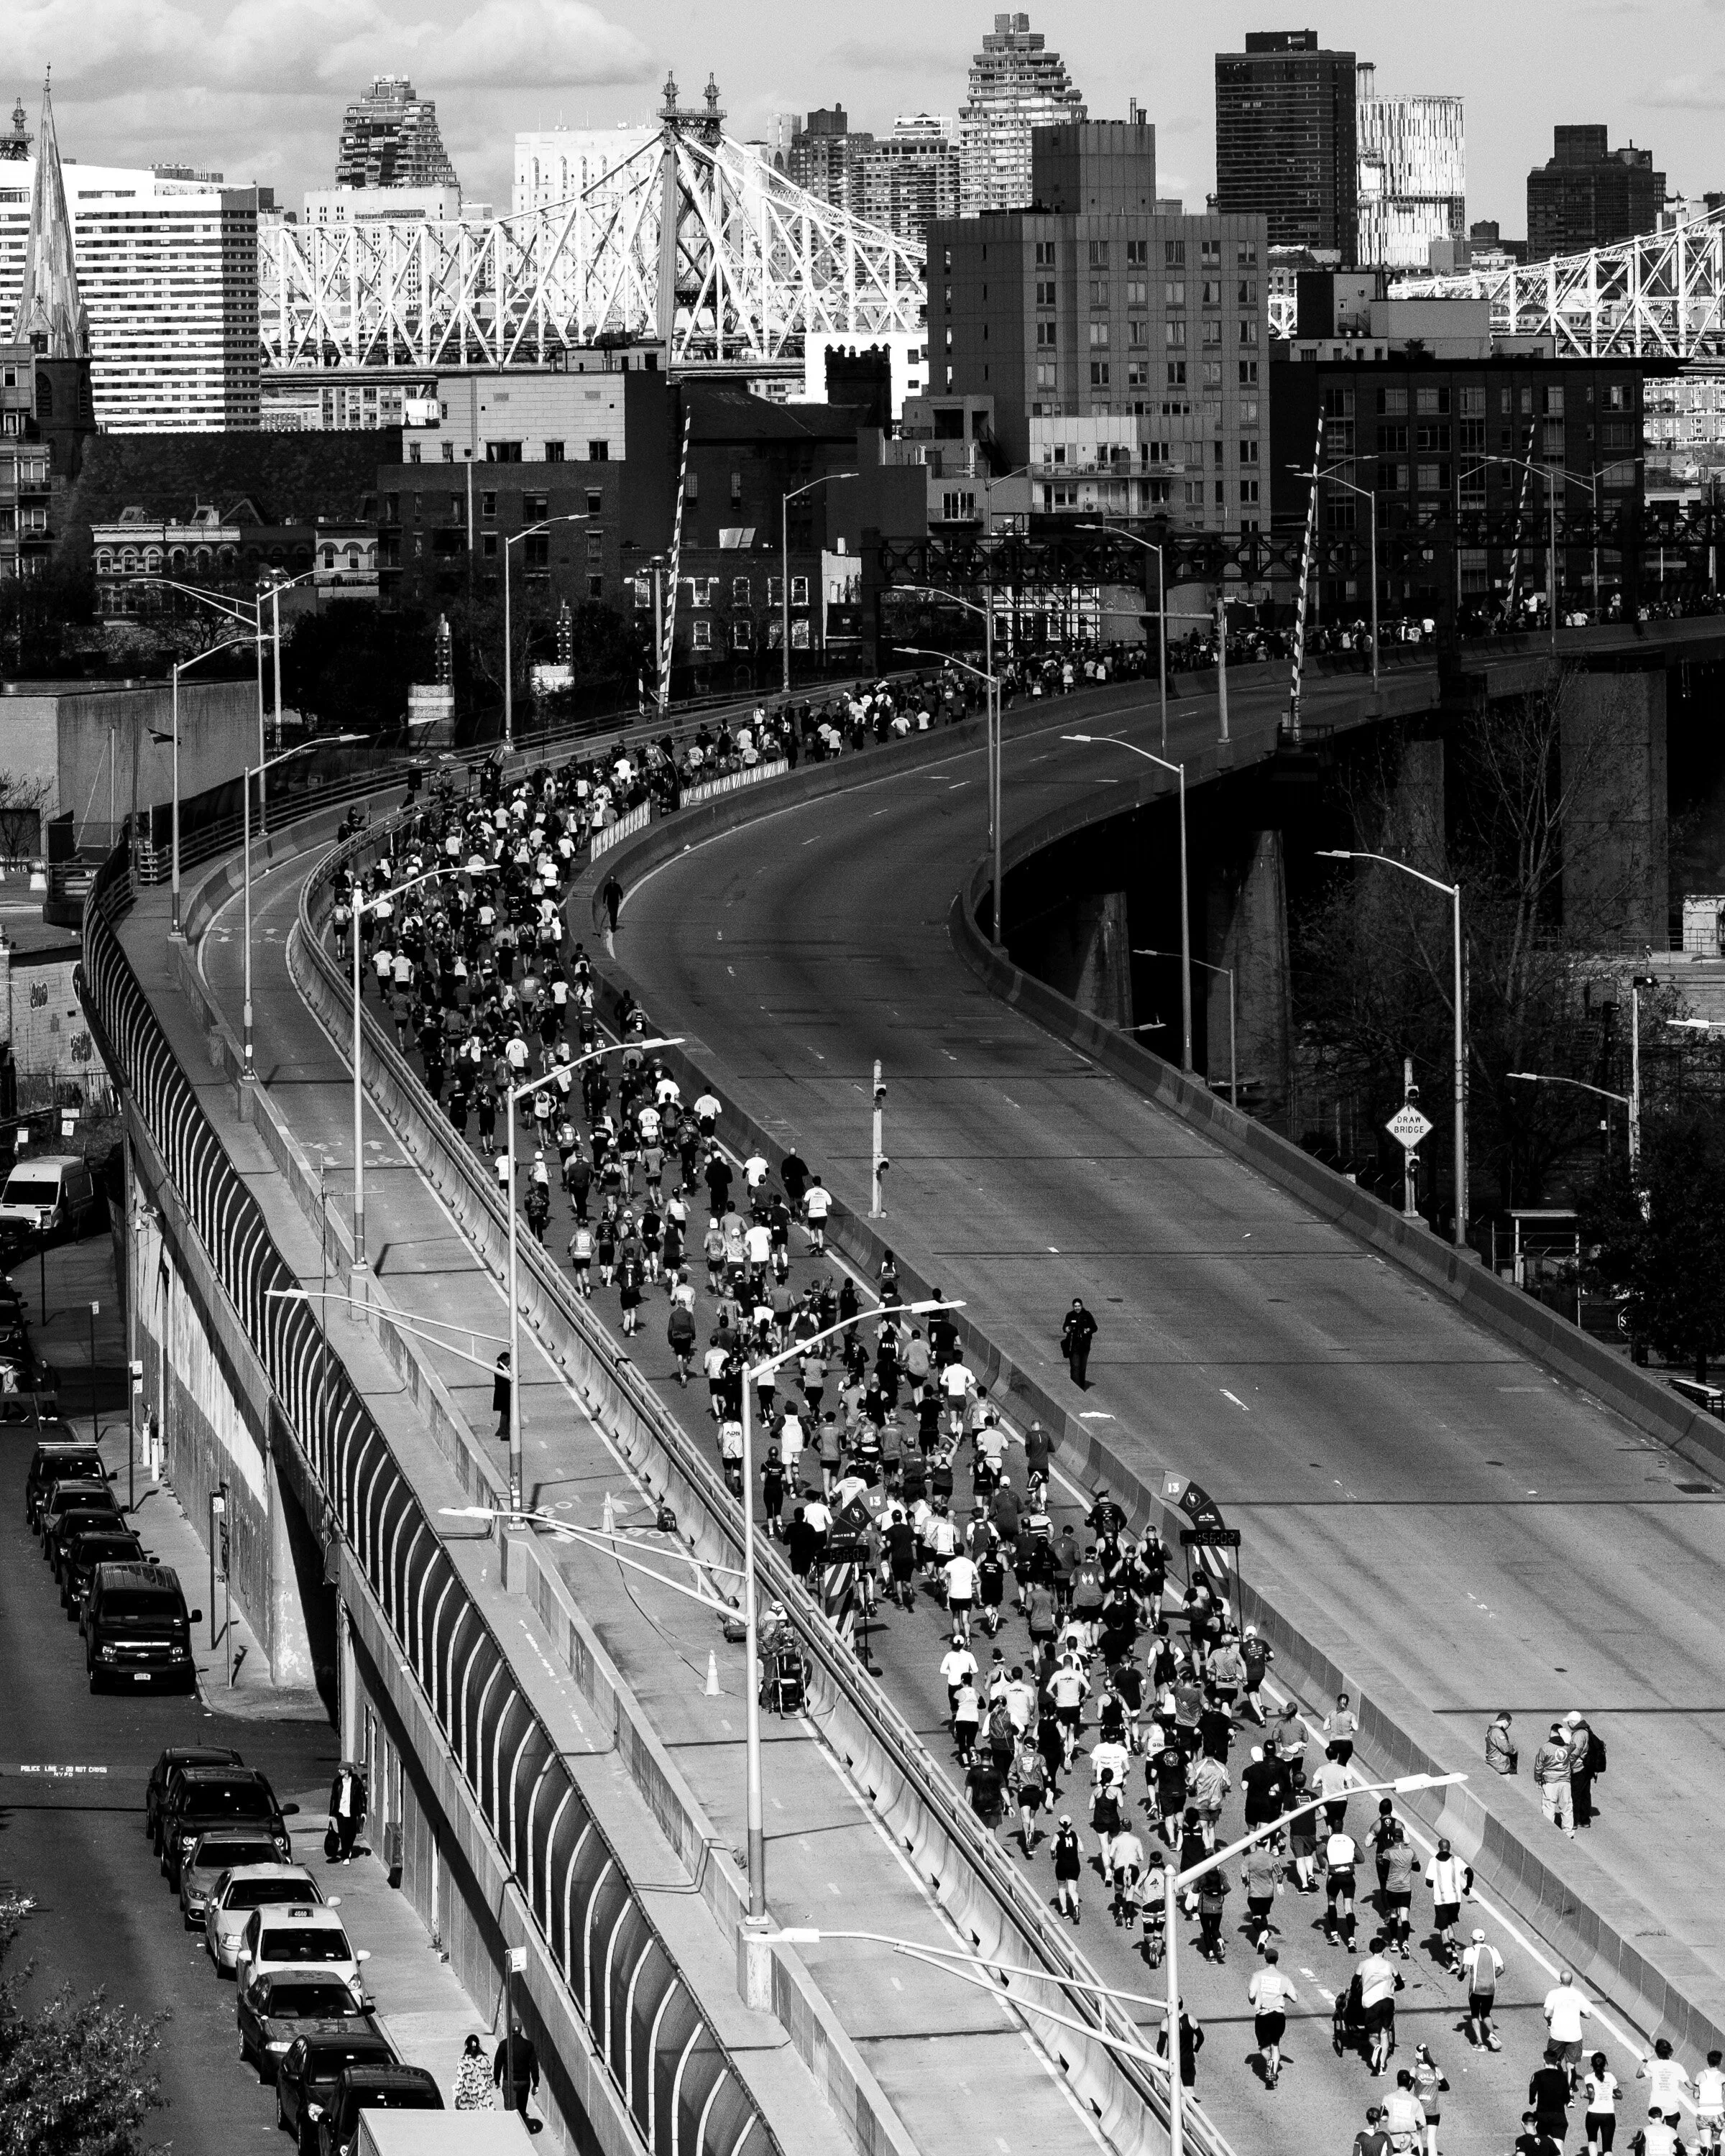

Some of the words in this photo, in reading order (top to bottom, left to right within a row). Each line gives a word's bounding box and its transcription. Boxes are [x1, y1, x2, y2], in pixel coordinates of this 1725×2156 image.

[635, 1022, 643, 1031] 3
[1168, 1483, 1179, 1493] 13
[869, 1496, 881, 1506] 13
[1065, 1837, 1073, 1848] H
